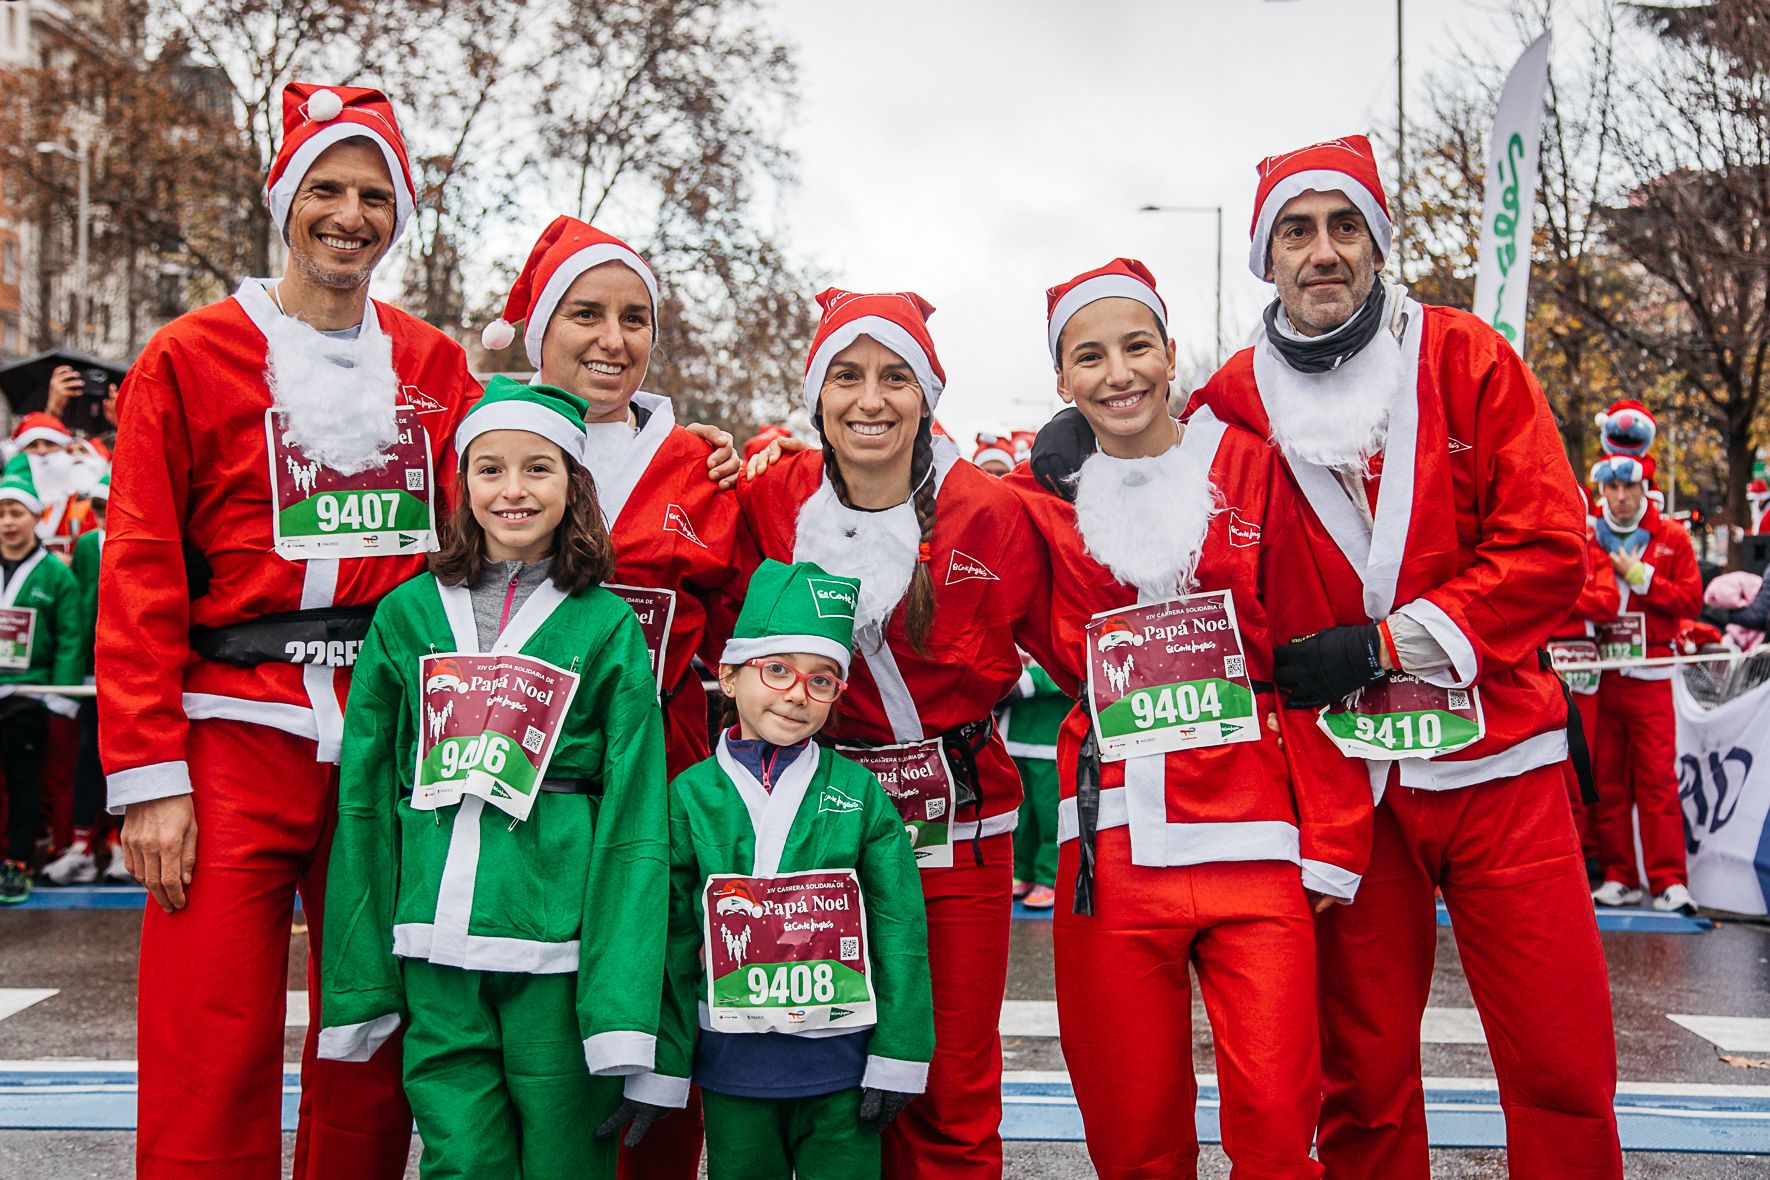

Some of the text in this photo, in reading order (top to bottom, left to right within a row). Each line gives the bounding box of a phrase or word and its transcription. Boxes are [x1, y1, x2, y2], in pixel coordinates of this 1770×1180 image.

[398, 428, 414, 445] el
[316, 493, 401, 532] 9407
[636, 609, 655, 625] el
[1157, 609, 1185, 619] CARRERA
[1186, 604, 1218, 614] SOLIDARIA
[1143, 620, 1189, 643] Papá
[488, 663, 513, 671] CARRERA
[513, 664, 545, 681] SOLIDARIA
[545, 676, 555, 685] DE
[469, 674, 554, 707] Papá Noel
[1130, 682, 1223, 729] 9404
[1354, 713, 1442, 748] 9410
[873, 762, 934, 785] pá Noel
[777, 885, 805, 893] CARRERA
[806, 882, 836, 890] SOLIDARIA
[764, 893, 850, 920] Papá Noel
[748, 963, 835, 1005] 9408
